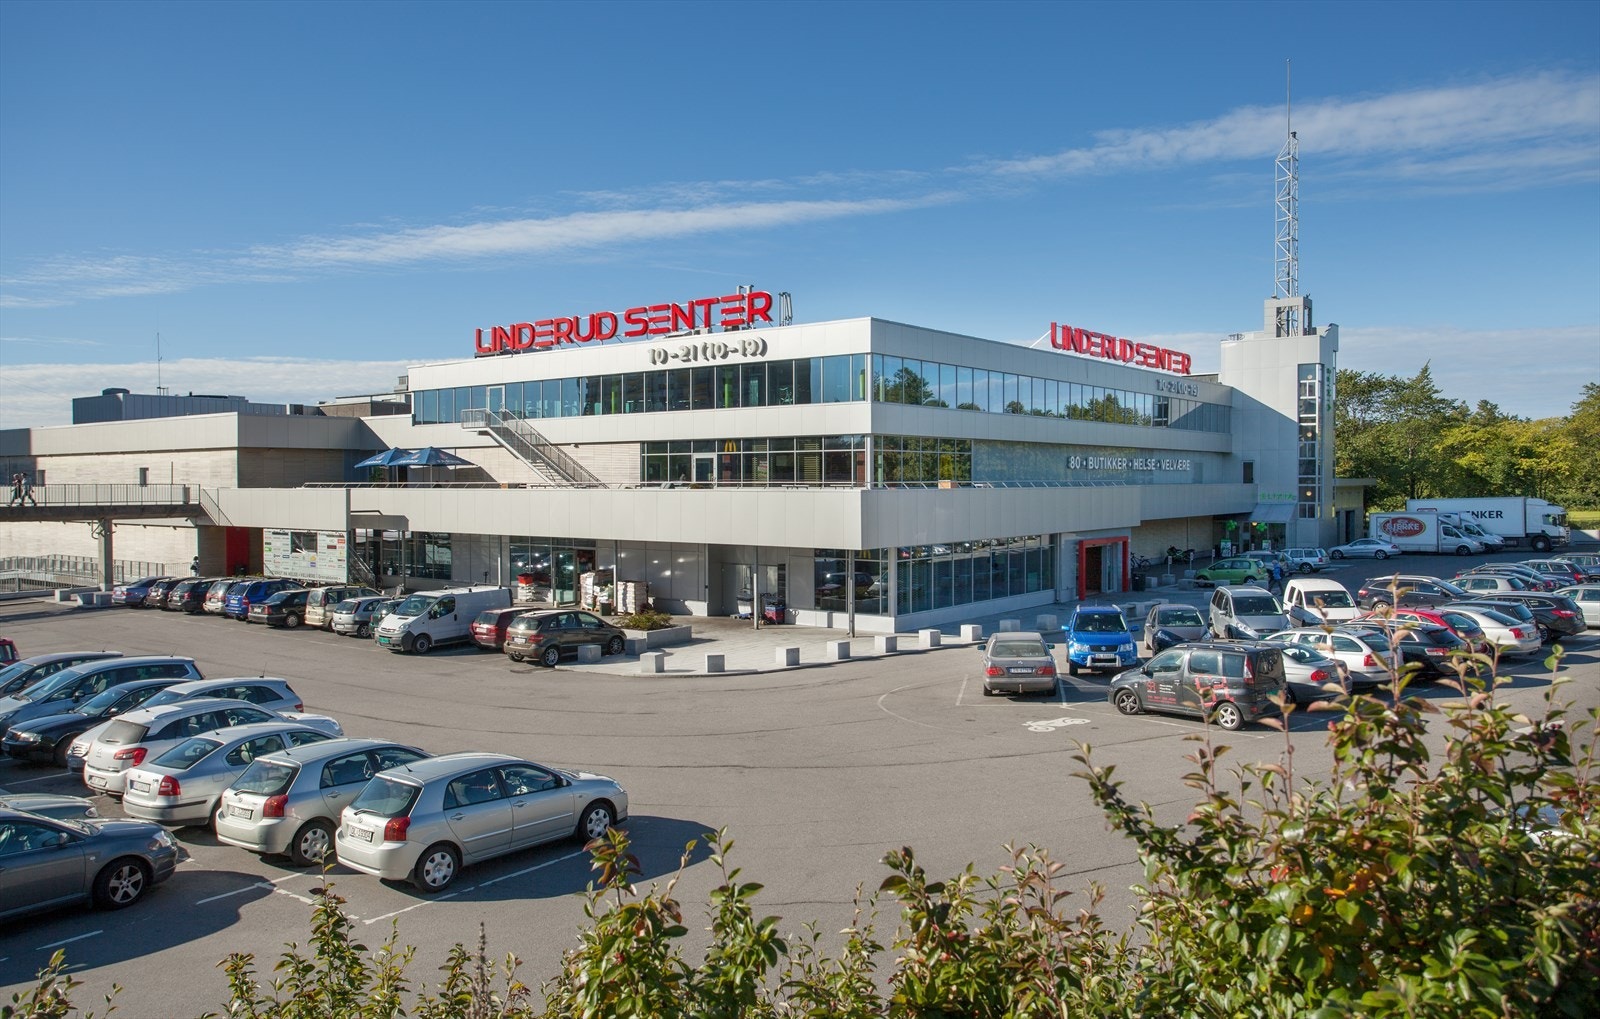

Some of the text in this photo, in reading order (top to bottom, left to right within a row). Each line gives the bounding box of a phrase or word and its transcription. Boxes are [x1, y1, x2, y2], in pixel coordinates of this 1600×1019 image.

[475, 291, 773, 353] LINDERUD SENTER
[1051, 322, 1192, 375] LINDERUD SENTER
[1069, 456, 1191, 471] 80 BUTIKKER HELSE VELVÆRE
